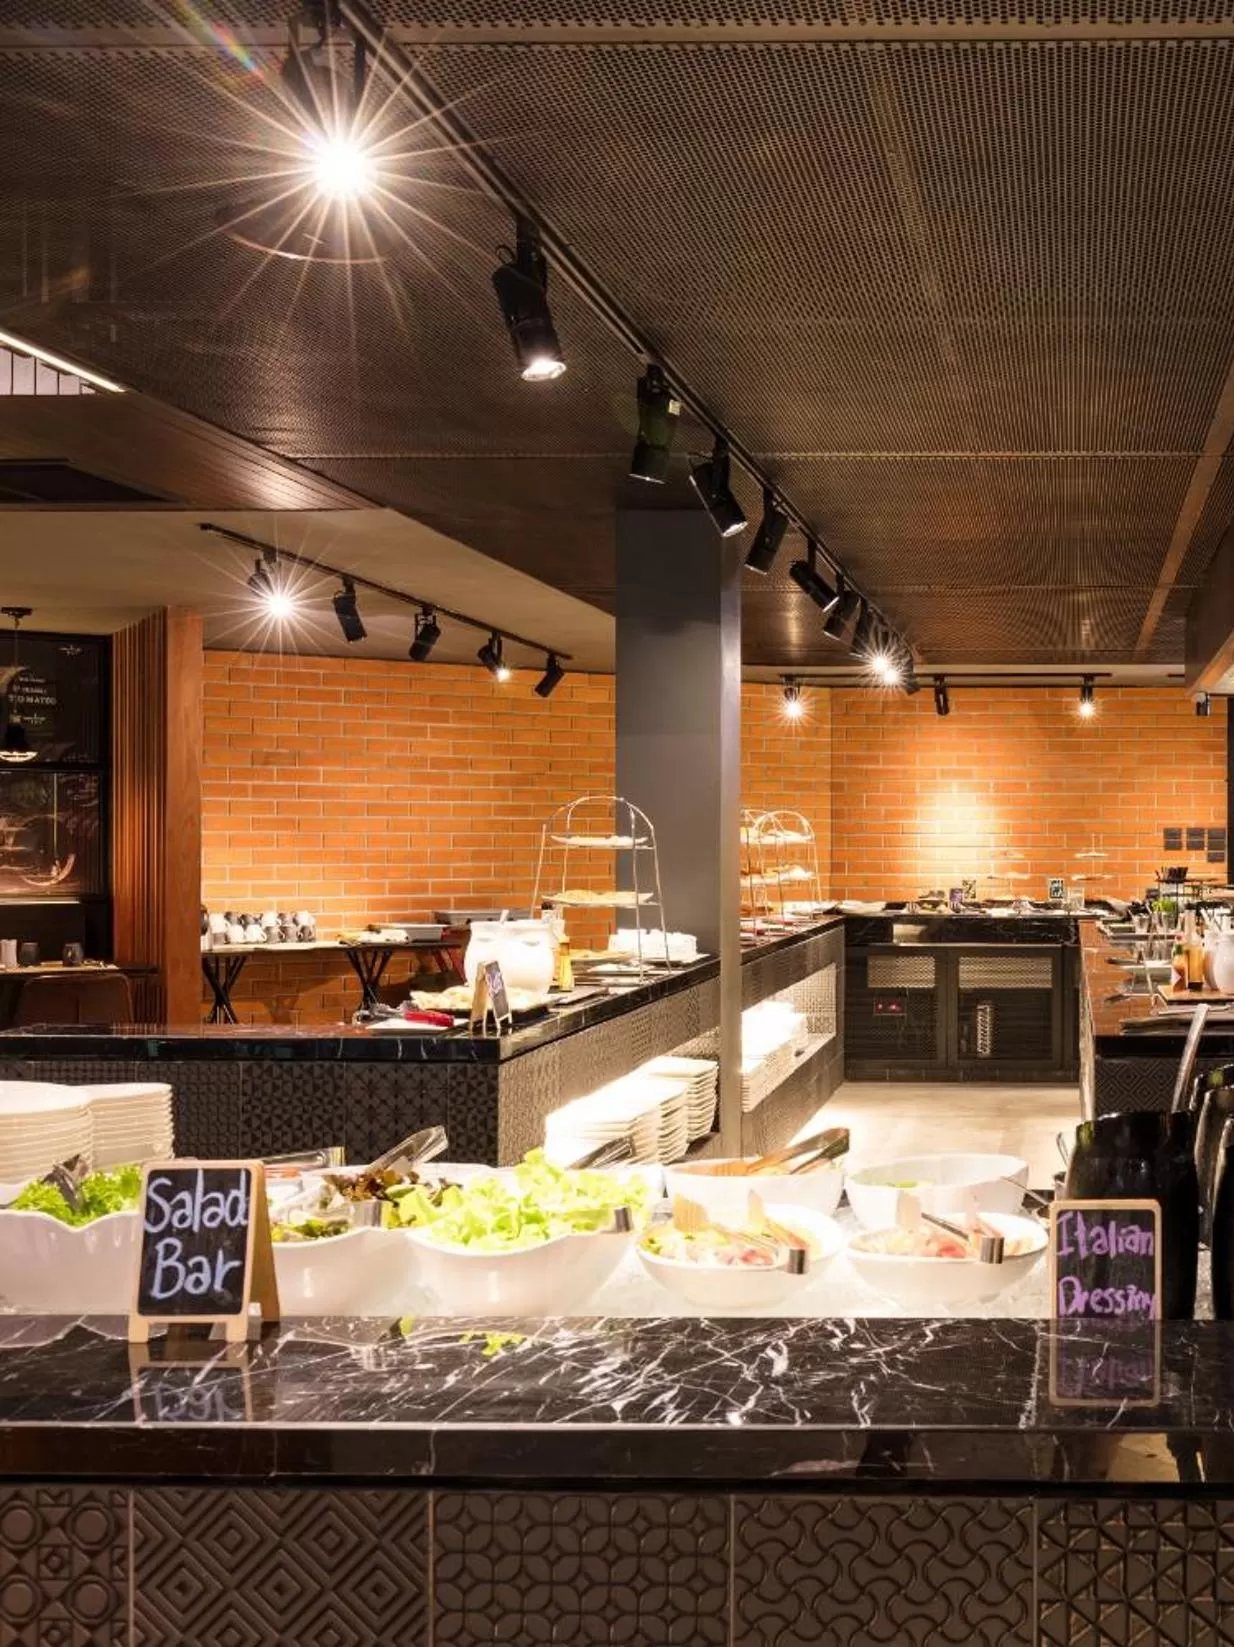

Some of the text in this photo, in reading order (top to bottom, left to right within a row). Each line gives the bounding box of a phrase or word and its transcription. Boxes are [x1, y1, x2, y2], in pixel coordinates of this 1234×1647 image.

[143, 1168, 250, 1233] Salad
[1057, 1211, 1154, 1259] Italian
[151, 1237, 242, 1299] Bar
